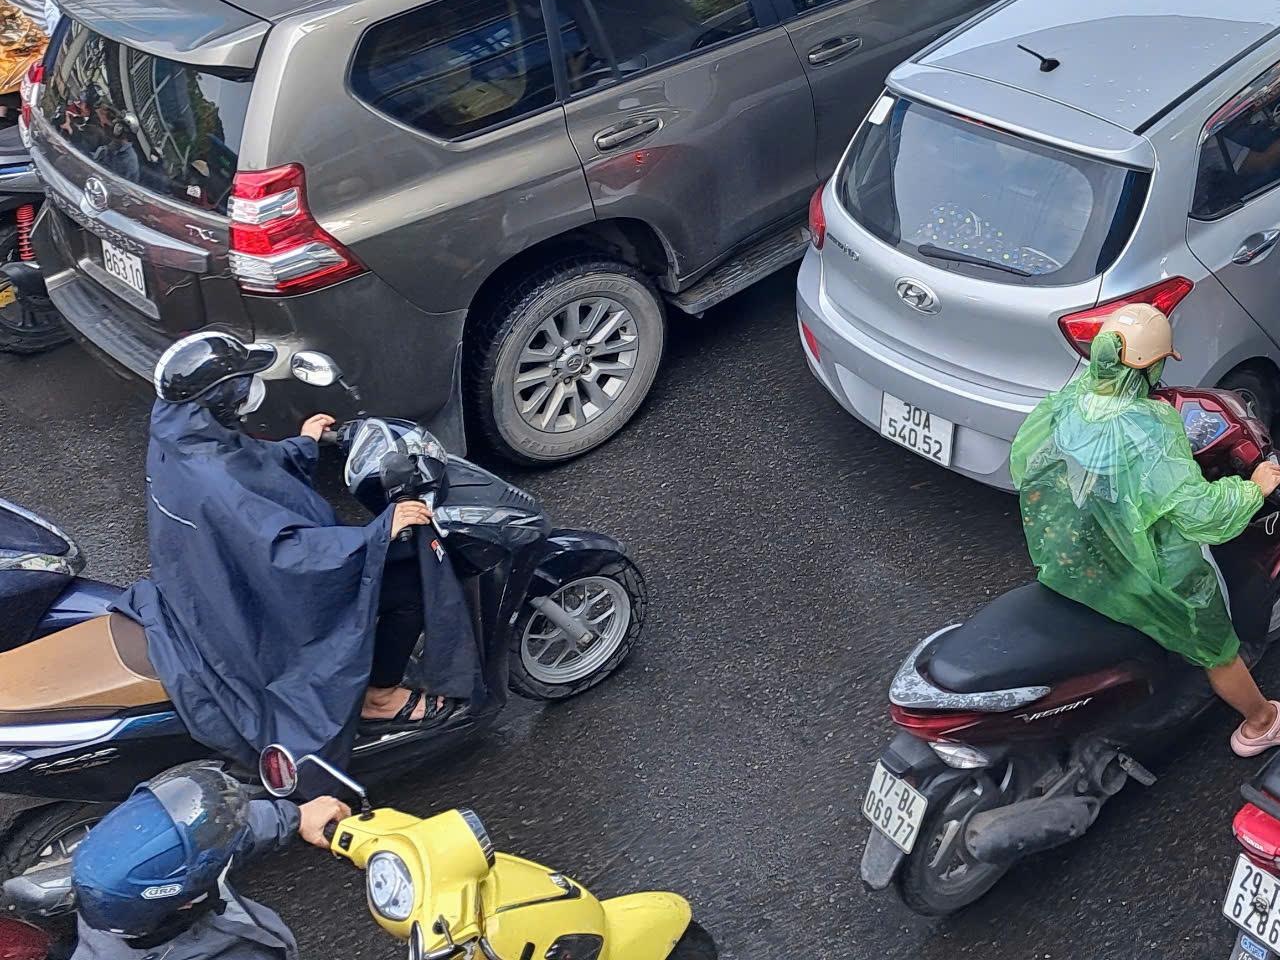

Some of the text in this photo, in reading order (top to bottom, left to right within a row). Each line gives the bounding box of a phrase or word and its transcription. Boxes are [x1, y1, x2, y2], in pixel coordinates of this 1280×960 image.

[104, 248, 144, 291] 863.10
[902, 401, 930, 433] 30A
[888, 417, 943, 461] 540.52
[879, 771, 914, 818] 17-B4
[866, 791, 915, 847] 069.77
[1241, 834, 1265, 852] HONDA
